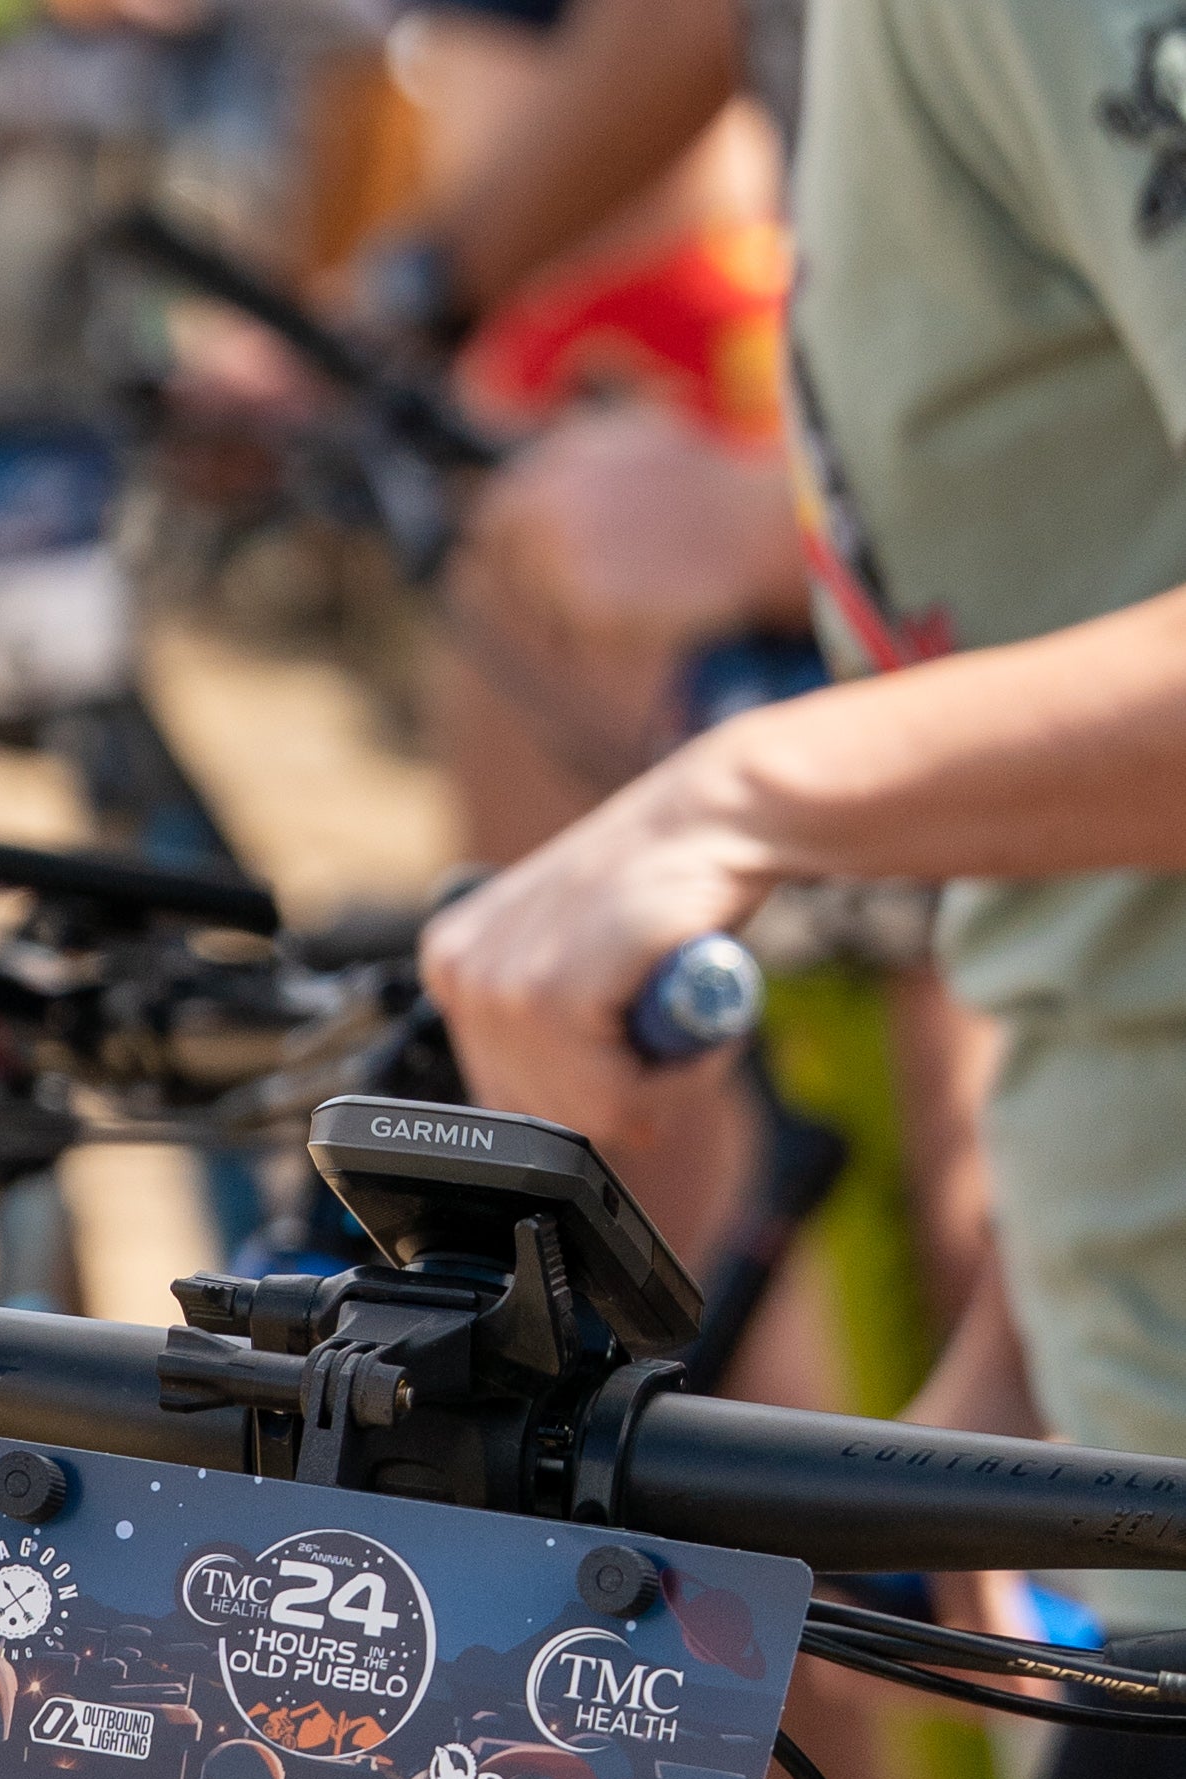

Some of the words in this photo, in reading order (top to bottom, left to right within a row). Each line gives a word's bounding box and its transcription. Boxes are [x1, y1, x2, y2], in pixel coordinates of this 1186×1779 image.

[370, 1116, 494, 1150] GARMIN
[841, 1440, 1075, 1482] CONTACT
[310, 1552, 356, 1568] ANNUAL
[201, 1568, 272, 1603] TMC
[270, 1560, 399, 1637] 24
[210, 1598, 269, 1619] HEALTH
[255, 1627, 358, 1664] HOURS
[368, 1645, 386, 1658] IN
[229, 1650, 287, 1678] OLD
[293, 1660, 408, 1697] PUEBLO
[362, 1656, 390, 1670] THE
[559, 1652, 685, 1714] TMC
[82, 1705, 152, 1735] OUTBOUND
[575, 1704, 678, 1743] HEALTH
[89, 1729, 149, 1757] LIGHTING
